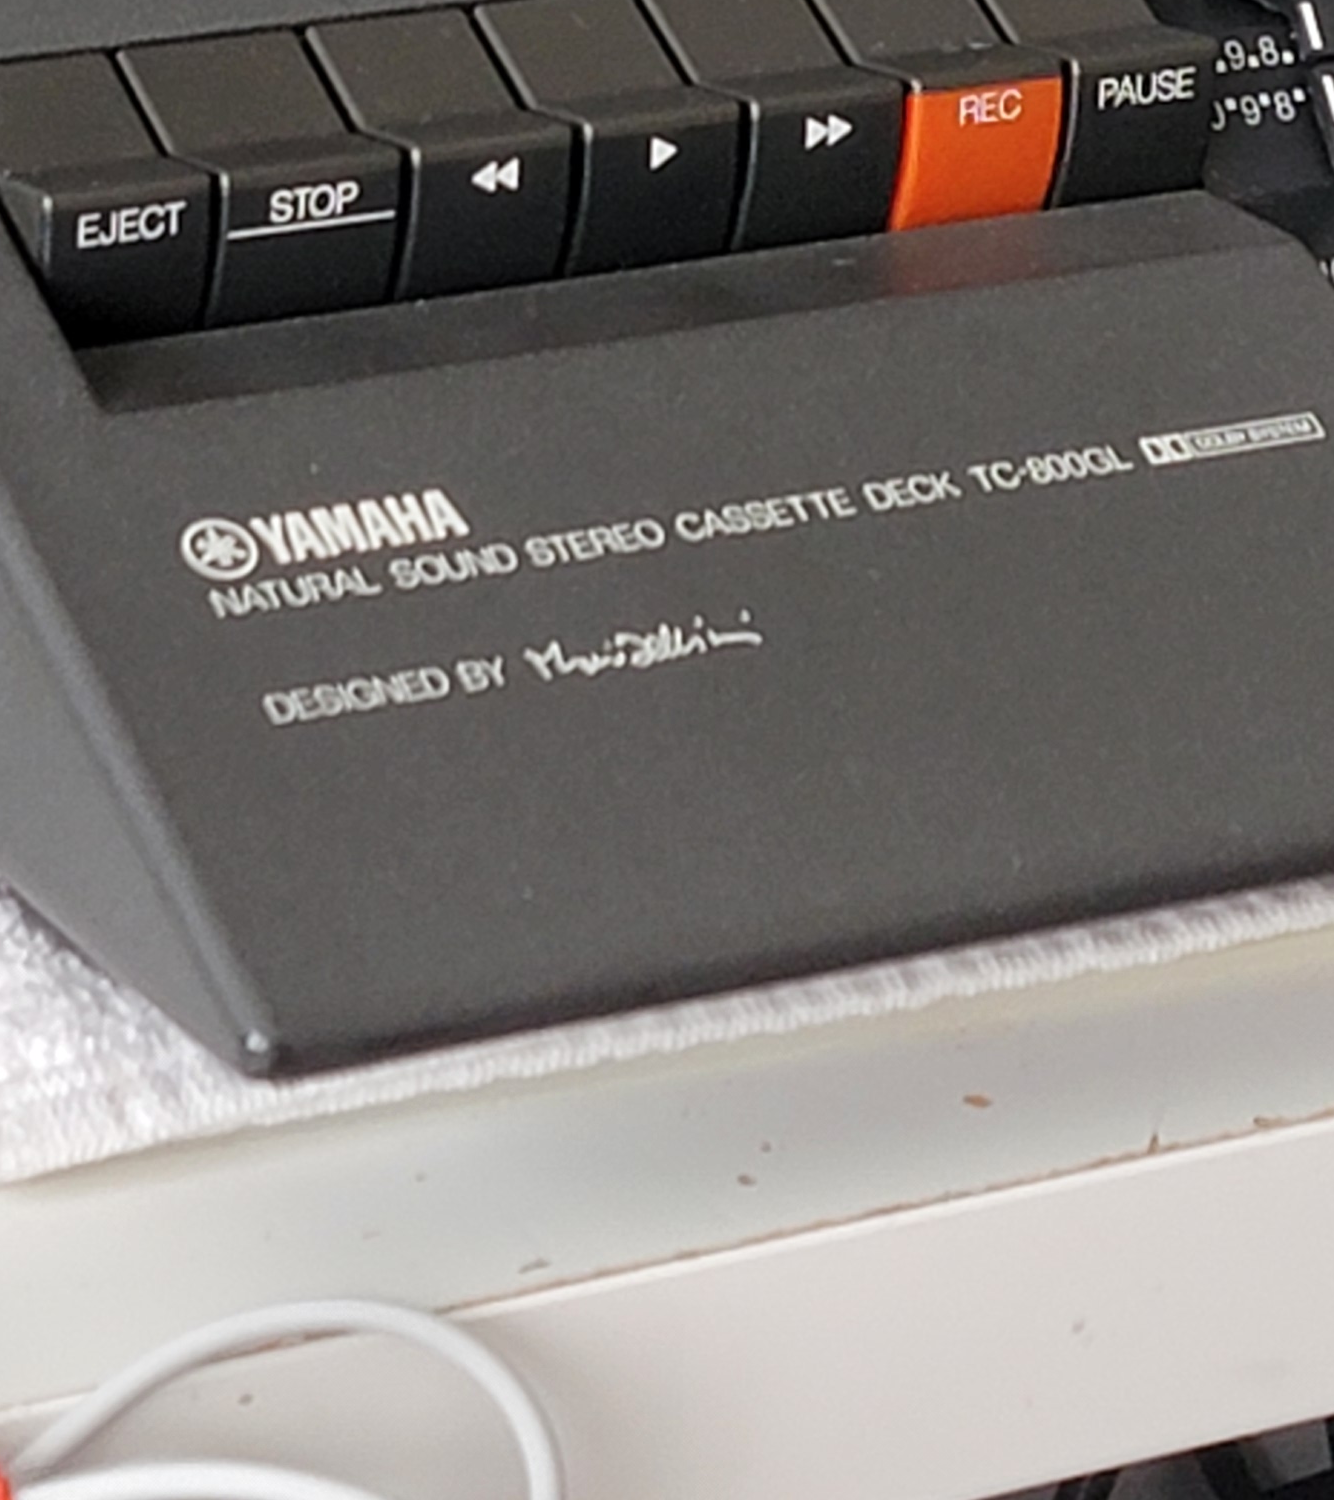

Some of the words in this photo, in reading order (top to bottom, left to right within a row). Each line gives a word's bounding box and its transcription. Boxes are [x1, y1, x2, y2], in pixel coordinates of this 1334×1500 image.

[959, 88, 1023, 127] REC
[1098, 66, 1196, 110] PAUSE
[76, 200, 187, 249] EJECT
[268, 180, 361, 223] STOP
[206, 563, 382, 618] NATURAL
[388, 541, 518, 589] SOUND
[524, 519, 665, 567] STEREO
[674, 487, 857, 542] CASSETTE
[862, 471, 962, 511] DECK
[967, 445, 1134, 492] TC-800GL
[249, 488, 471, 566] YAMAHA
[262, 667, 450, 725] DESIGNED
[455, 655, 505, 693] BY
